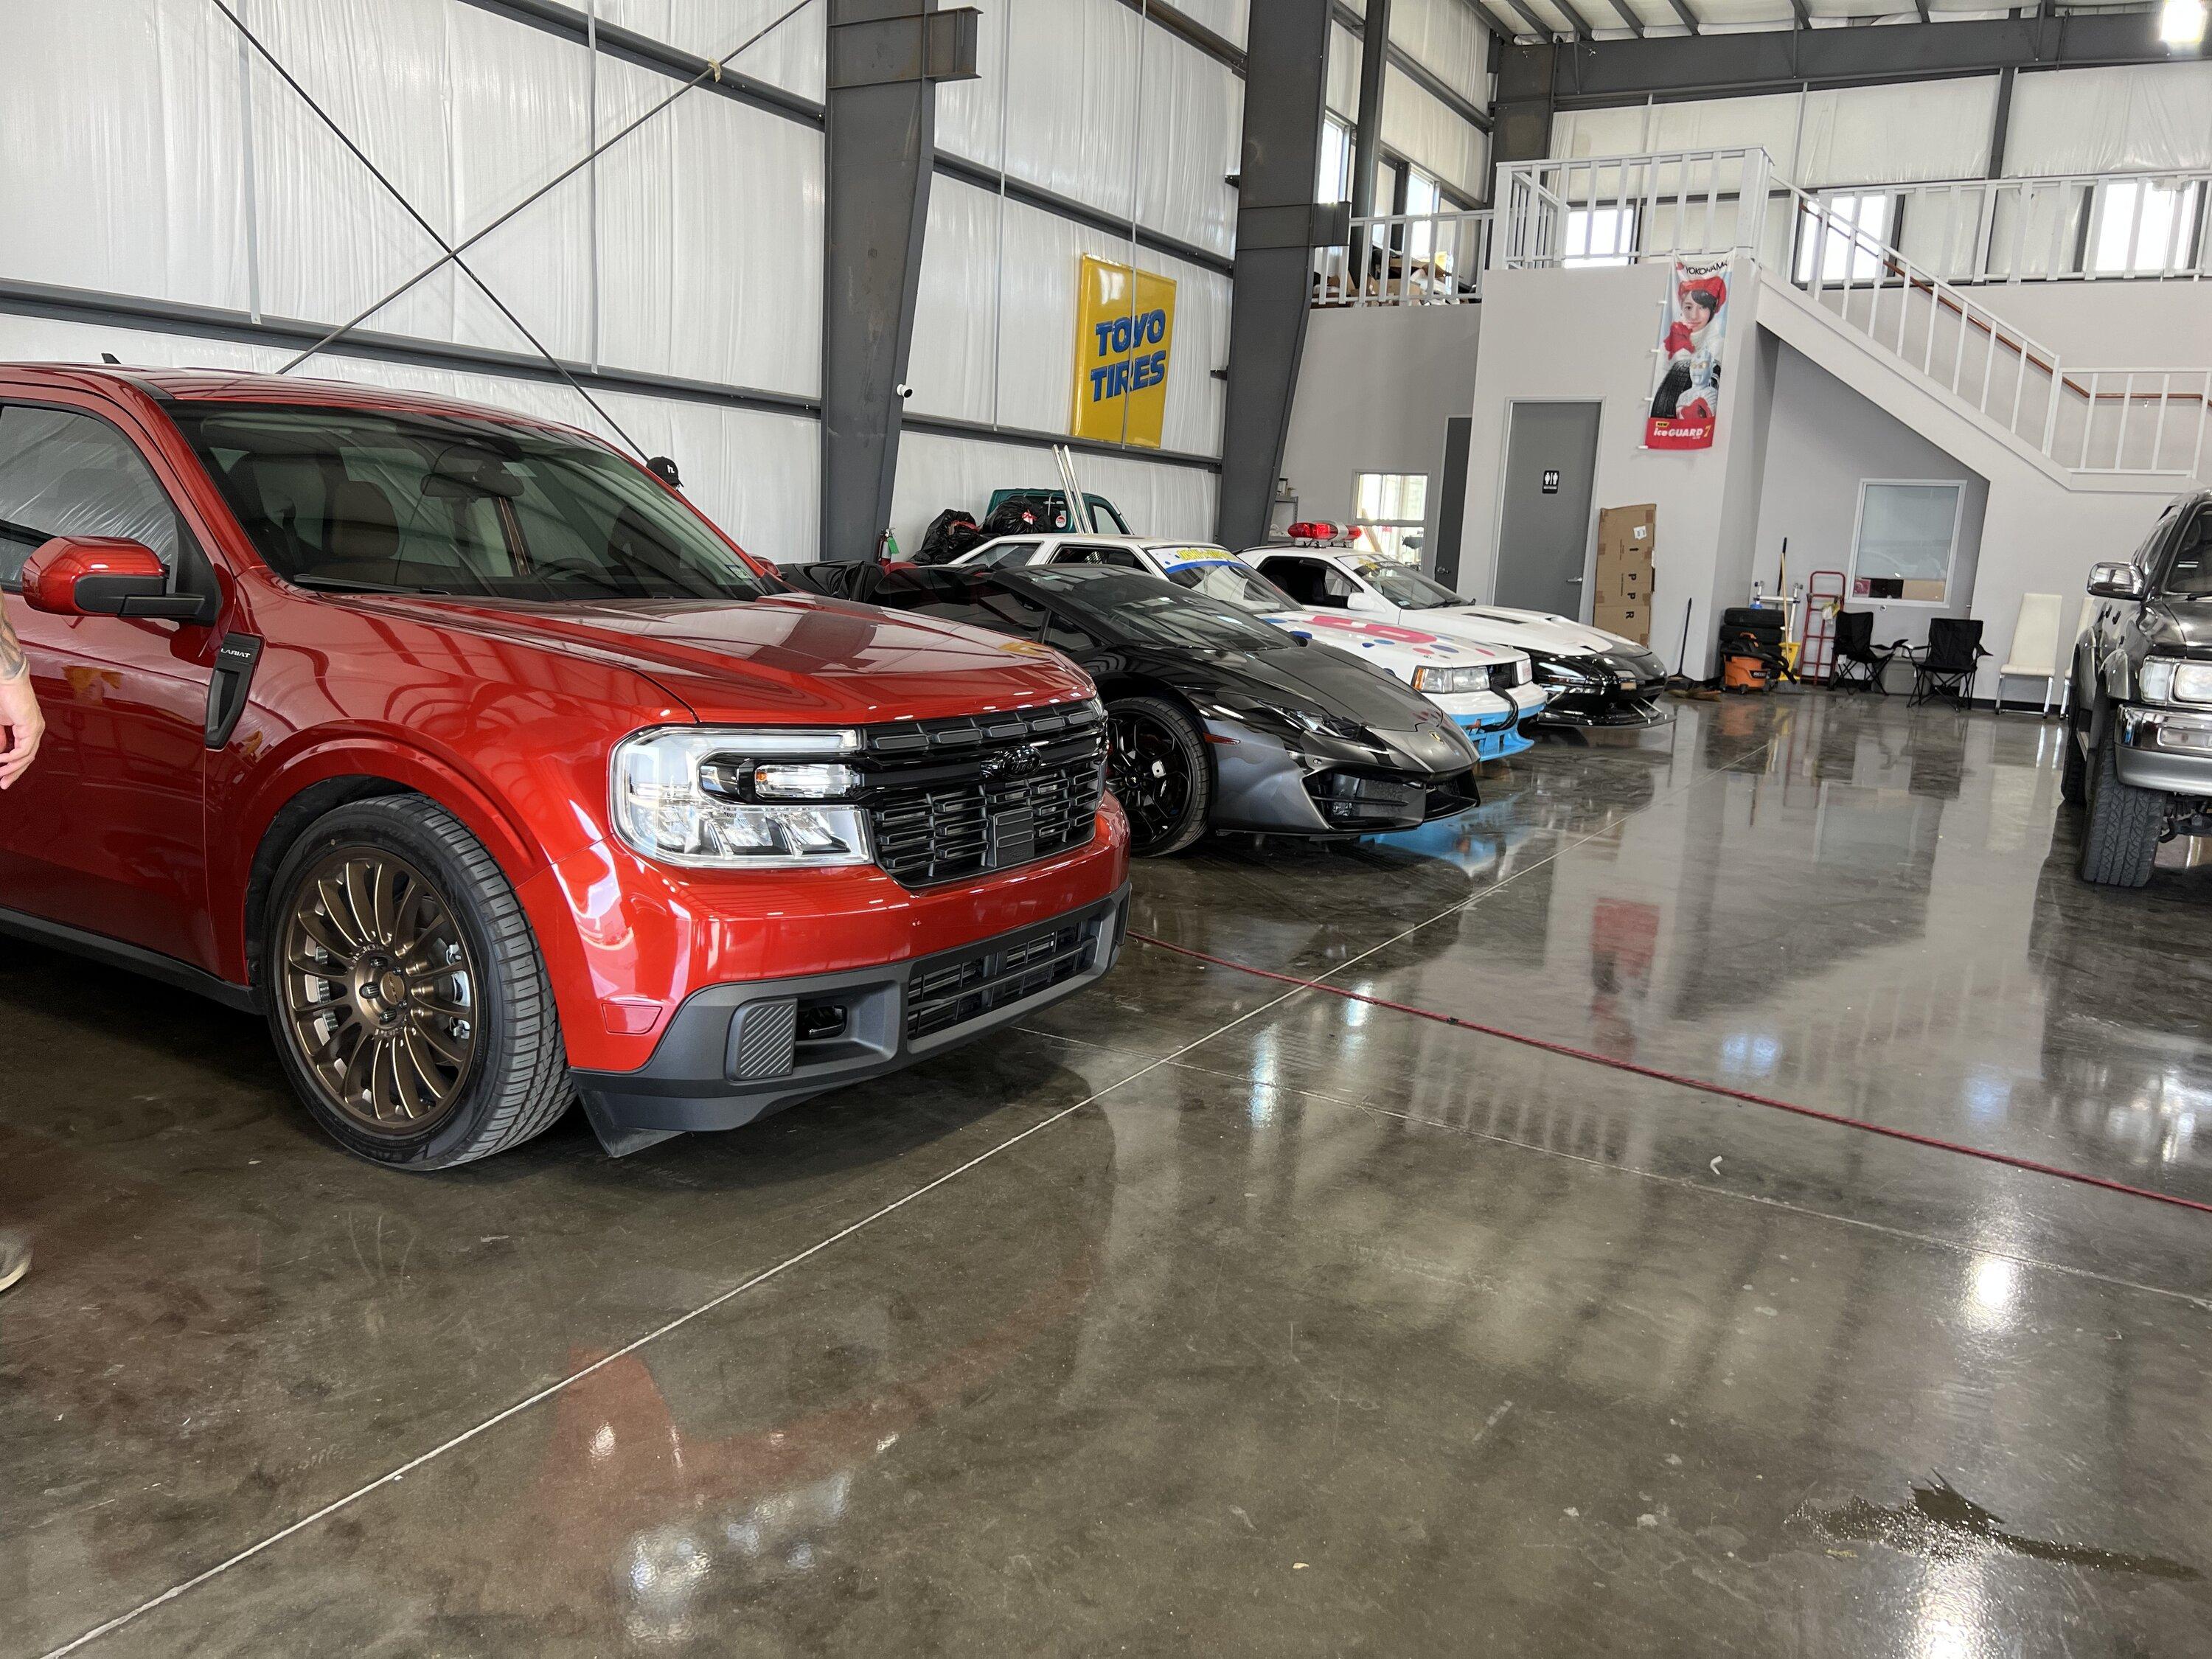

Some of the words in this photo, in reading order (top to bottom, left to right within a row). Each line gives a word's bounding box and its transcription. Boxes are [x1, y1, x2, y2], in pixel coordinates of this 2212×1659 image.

[1096, 308, 1166, 357] TOYO
[1090, 350, 1166, 402] TIRES
[1703, 425, 1711, 437] 7
[220, 647, 250, 658] LARIAT
